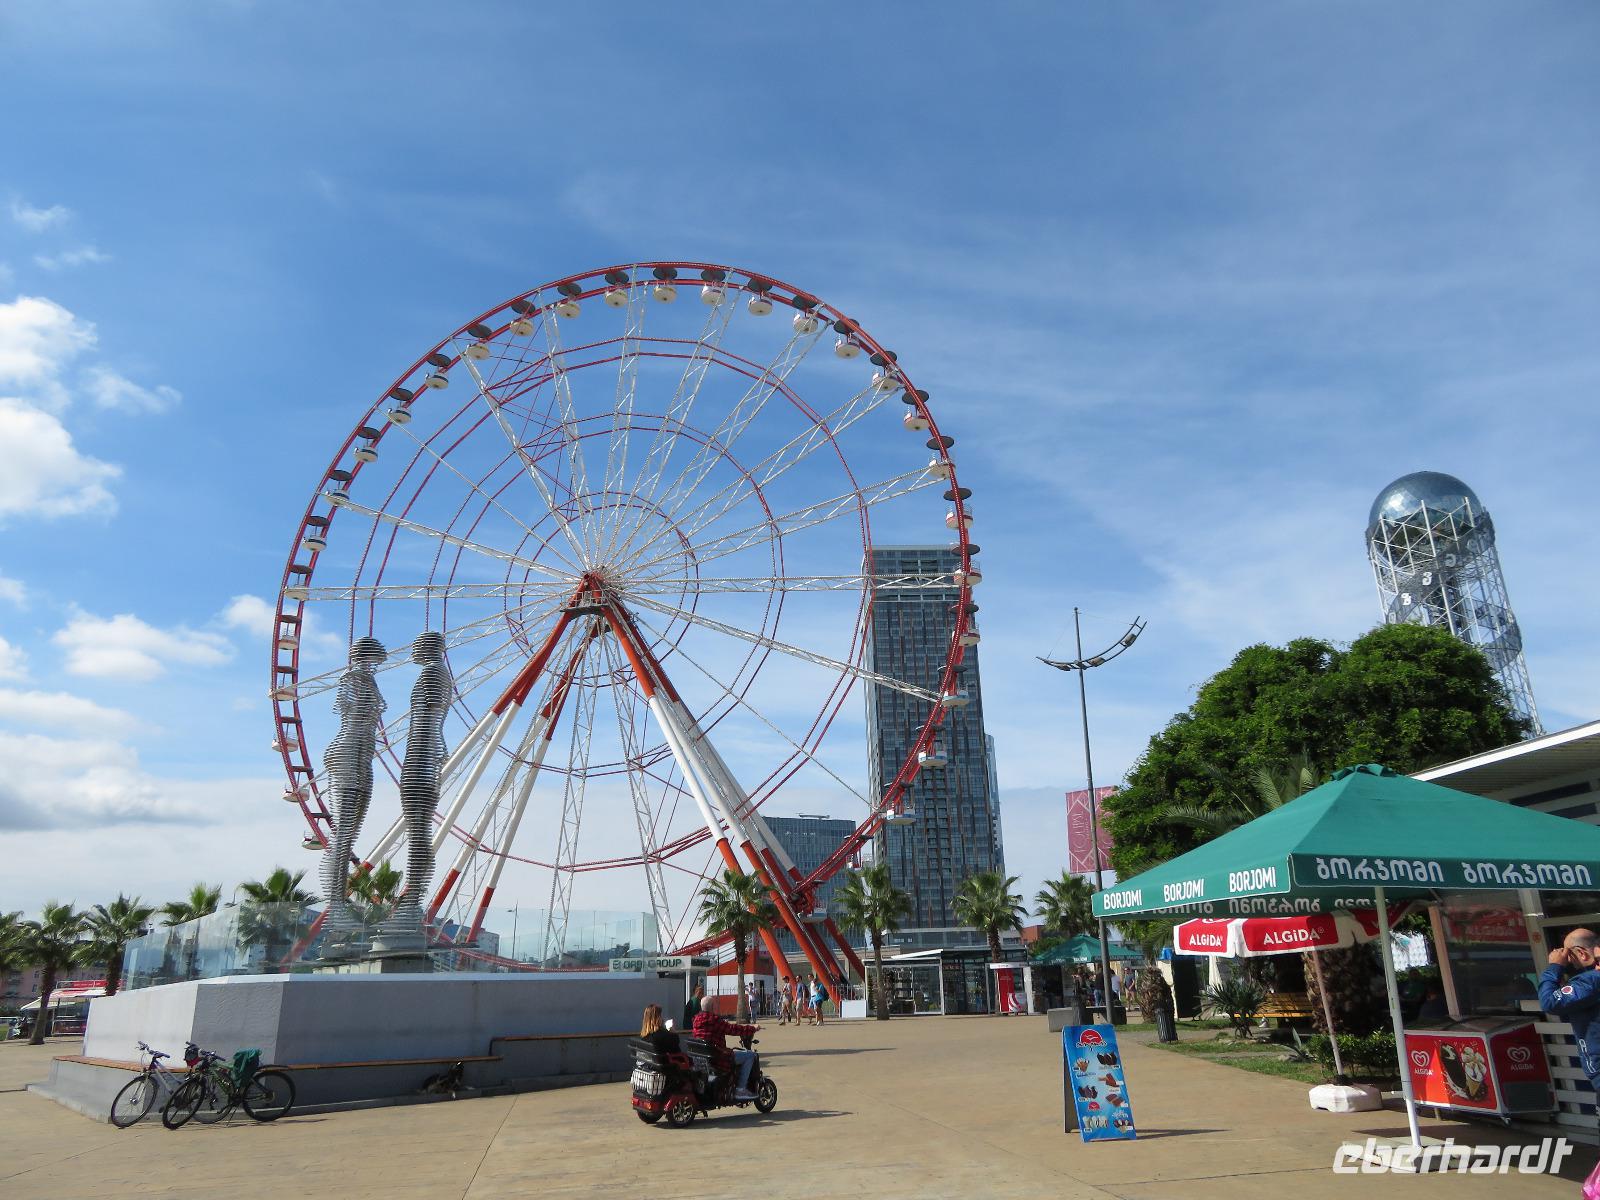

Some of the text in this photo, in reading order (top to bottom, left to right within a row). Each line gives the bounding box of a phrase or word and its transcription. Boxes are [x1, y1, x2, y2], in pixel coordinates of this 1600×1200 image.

[1315, 857, 1592, 886] ბორჯომი ბორჯომი
[1103, 889, 1142, 910] BORJOMI
[1163, 878, 1204, 903] BORJOMI
[1229, 867, 1276, 893] BORJOMI
[648, 959, 682, 968] GROUP
